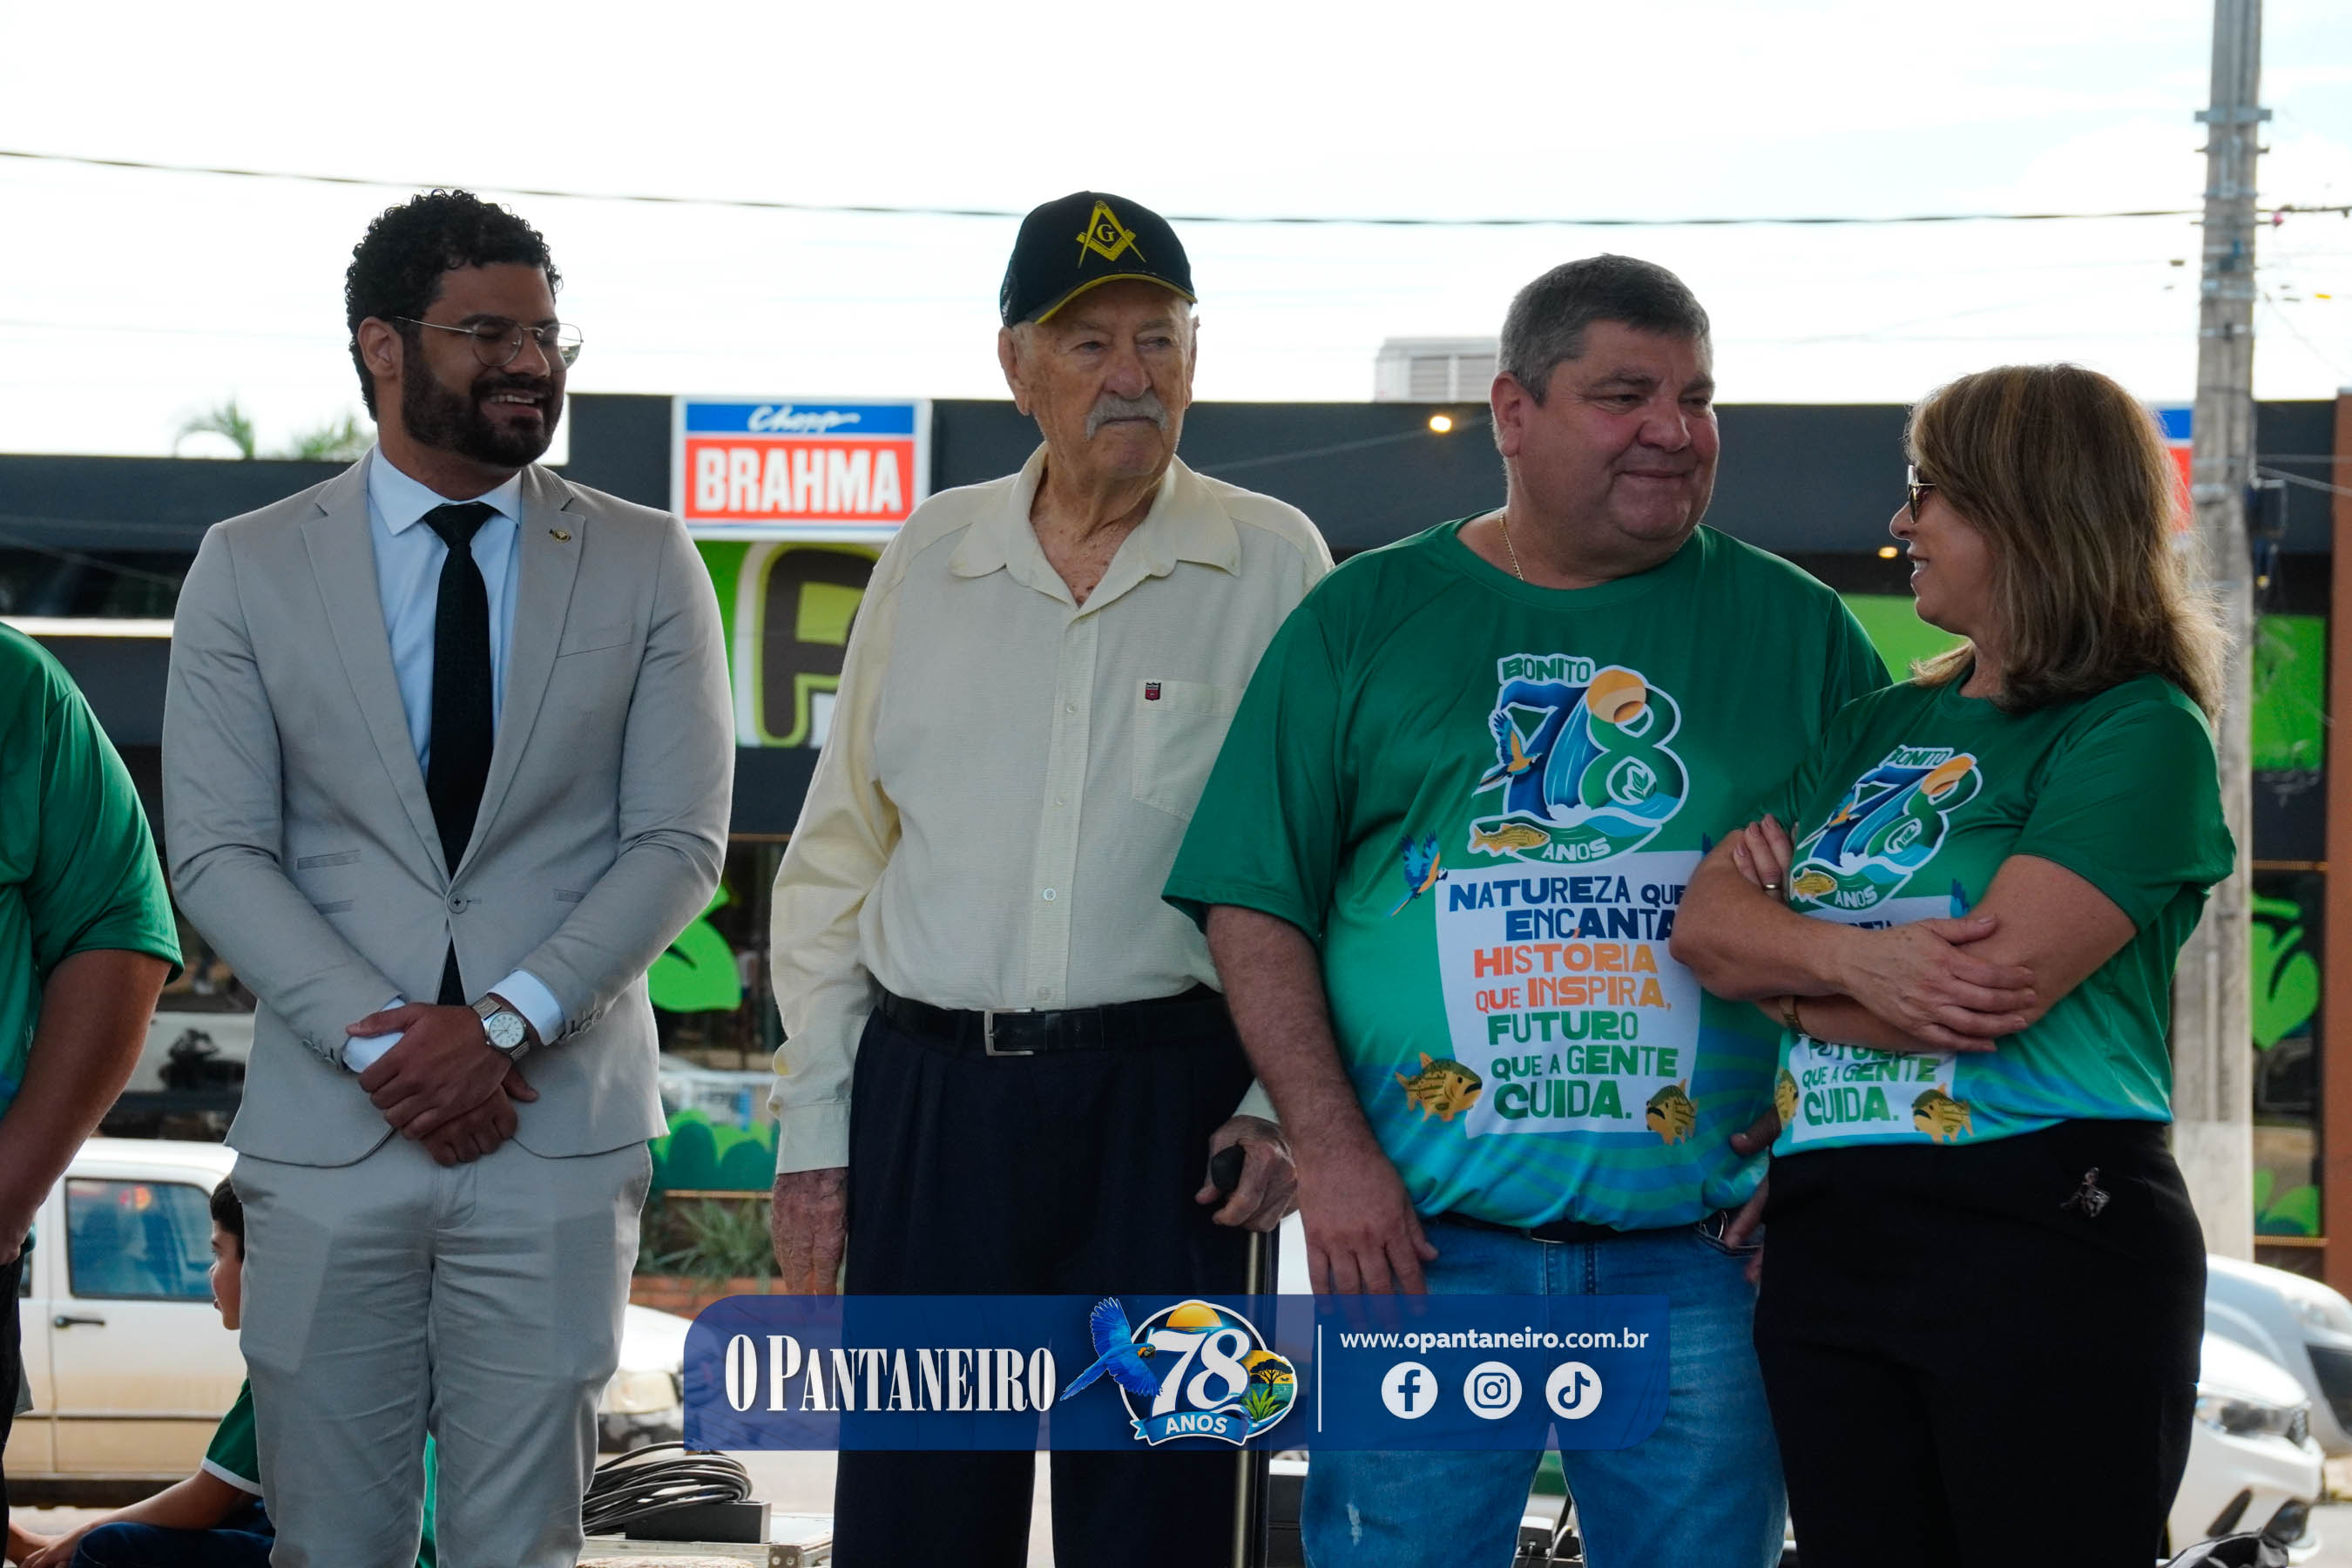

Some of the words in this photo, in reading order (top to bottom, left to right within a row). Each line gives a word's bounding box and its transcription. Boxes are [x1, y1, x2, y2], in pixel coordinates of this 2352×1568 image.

[1096, 224, 1116, 242] G
[747, 404, 862, 434] Chopp
[695, 448, 903, 513] BRAHMA
[1502, 656, 1592, 683] BONITO
[1497, 666, 1690, 826] 78
[1885, 748, 1950, 766] BONITO
[1541, 836, 1611, 862] ANOS
[1449, 875, 1631, 912] NATUREZA
[1835, 884, 1877, 908] ANOS
[1505, 908, 1675, 942] ENCANTA
[1475, 987, 1521, 1013] QUE
[1527, 977, 1672, 1011] INSPIRA,
[1487, 1010, 1639, 1045] FUTURO
[1490, 1055, 1542, 1082] QUE
[1550, 1053, 1560, 1075] A
[1567, 1045, 1679, 1078] GENTE
[1801, 1066, 1828, 1090] QUE
[1830, 1065, 1840, 1084] A
[1842, 1056, 1942, 1083] GENTE
[1493, 1079, 1632, 1120] CUIDA.
[1804, 1086, 1899, 1126] CUIDA.
